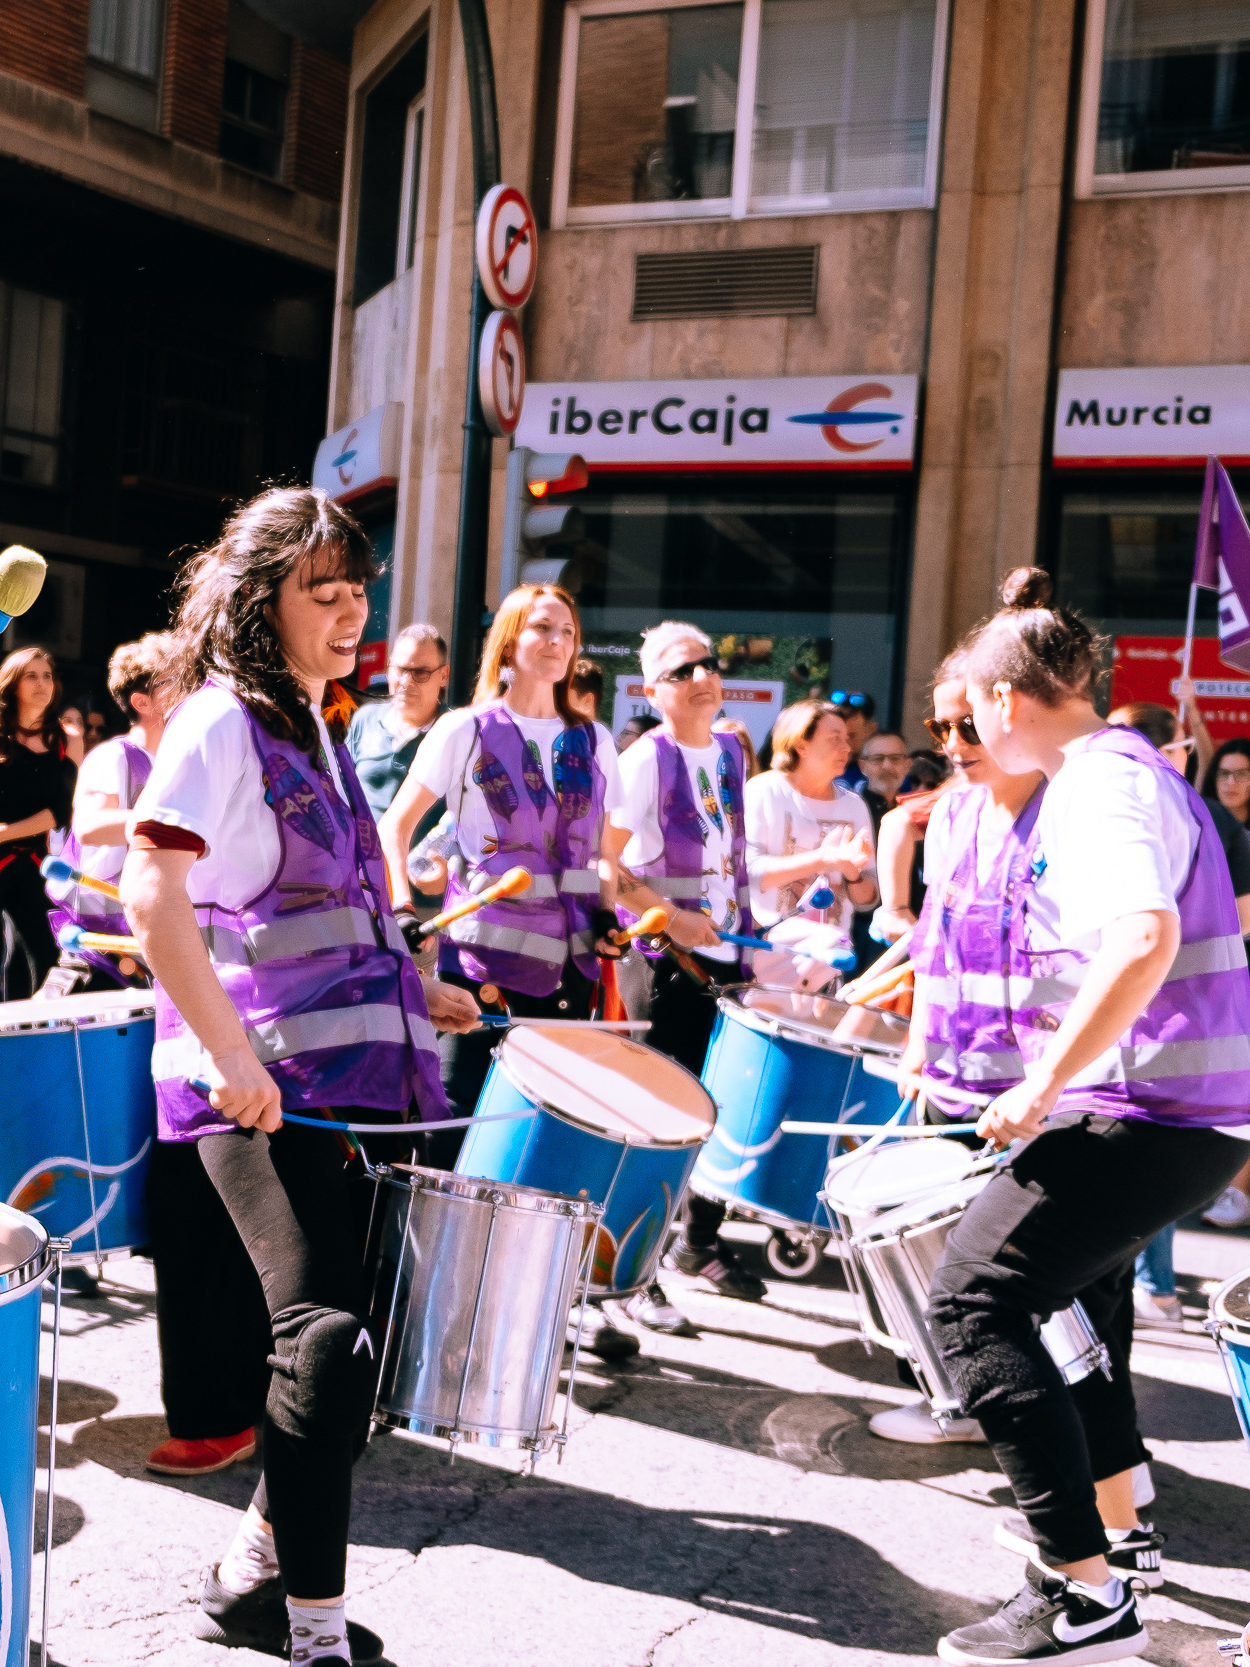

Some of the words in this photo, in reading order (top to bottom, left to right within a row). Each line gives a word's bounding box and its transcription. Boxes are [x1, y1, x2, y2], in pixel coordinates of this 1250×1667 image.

[1065, 395, 1211, 427] Murcia
[549, 394, 769, 446] iberCaja
[588, 644, 630, 656] iberCaja
[1197, 683, 1250, 693] POTECA
[725, 691, 755, 701] PASO
